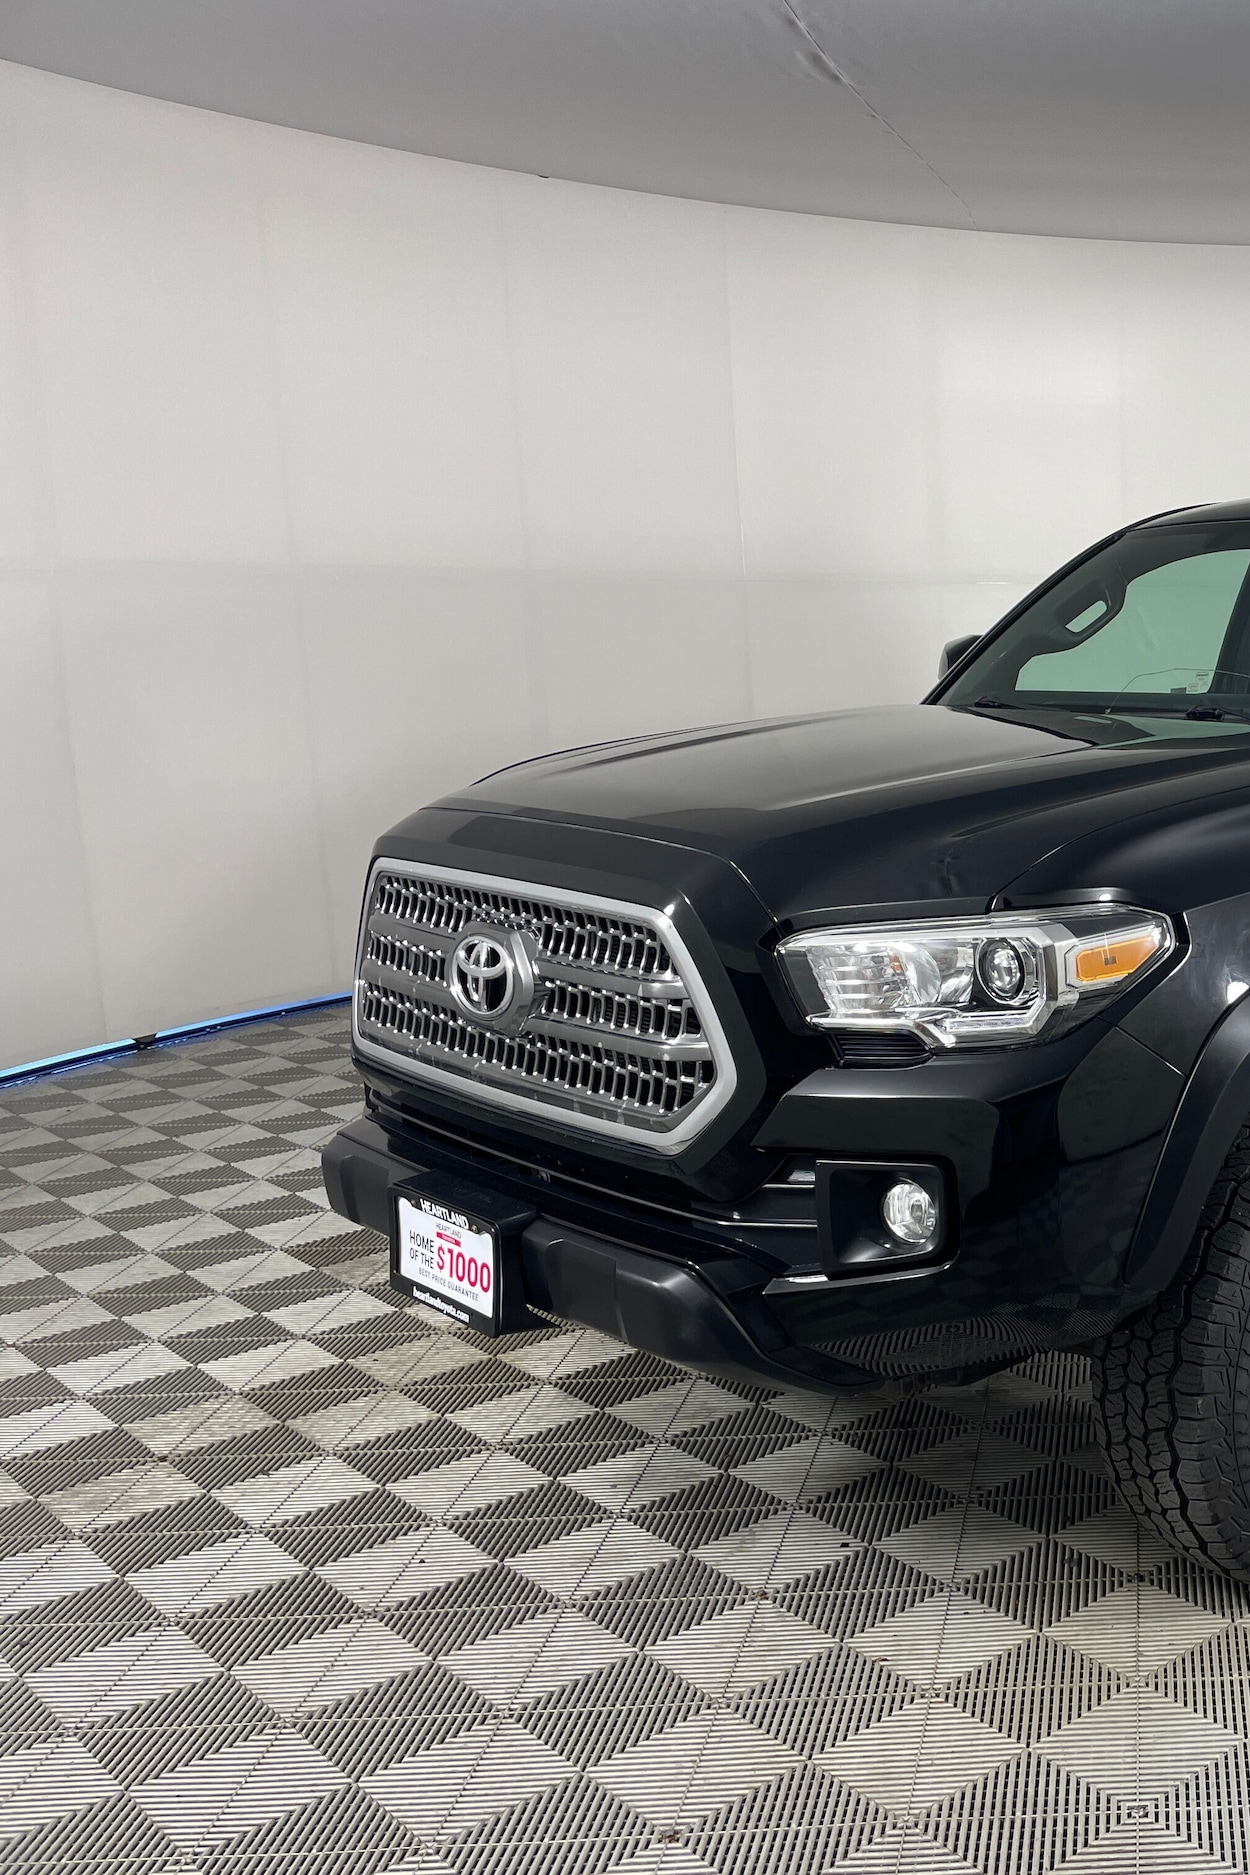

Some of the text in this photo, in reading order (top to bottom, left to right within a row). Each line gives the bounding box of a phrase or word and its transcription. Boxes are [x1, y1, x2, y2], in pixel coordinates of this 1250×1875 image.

[420, 1198, 469, 1229] HEARTLAND
[409, 1230, 434, 1254] HOME
[435, 1222, 462, 1239] HEARTLAND
[409, 1247, 435, 1270] OF THE
[437, 1244, 491, 1292] $1000
[418, 1268, 479, 1302] BEST PRICE GUARANTEE
[412, 1286, 470, 1323] heartlandtoyota.com
